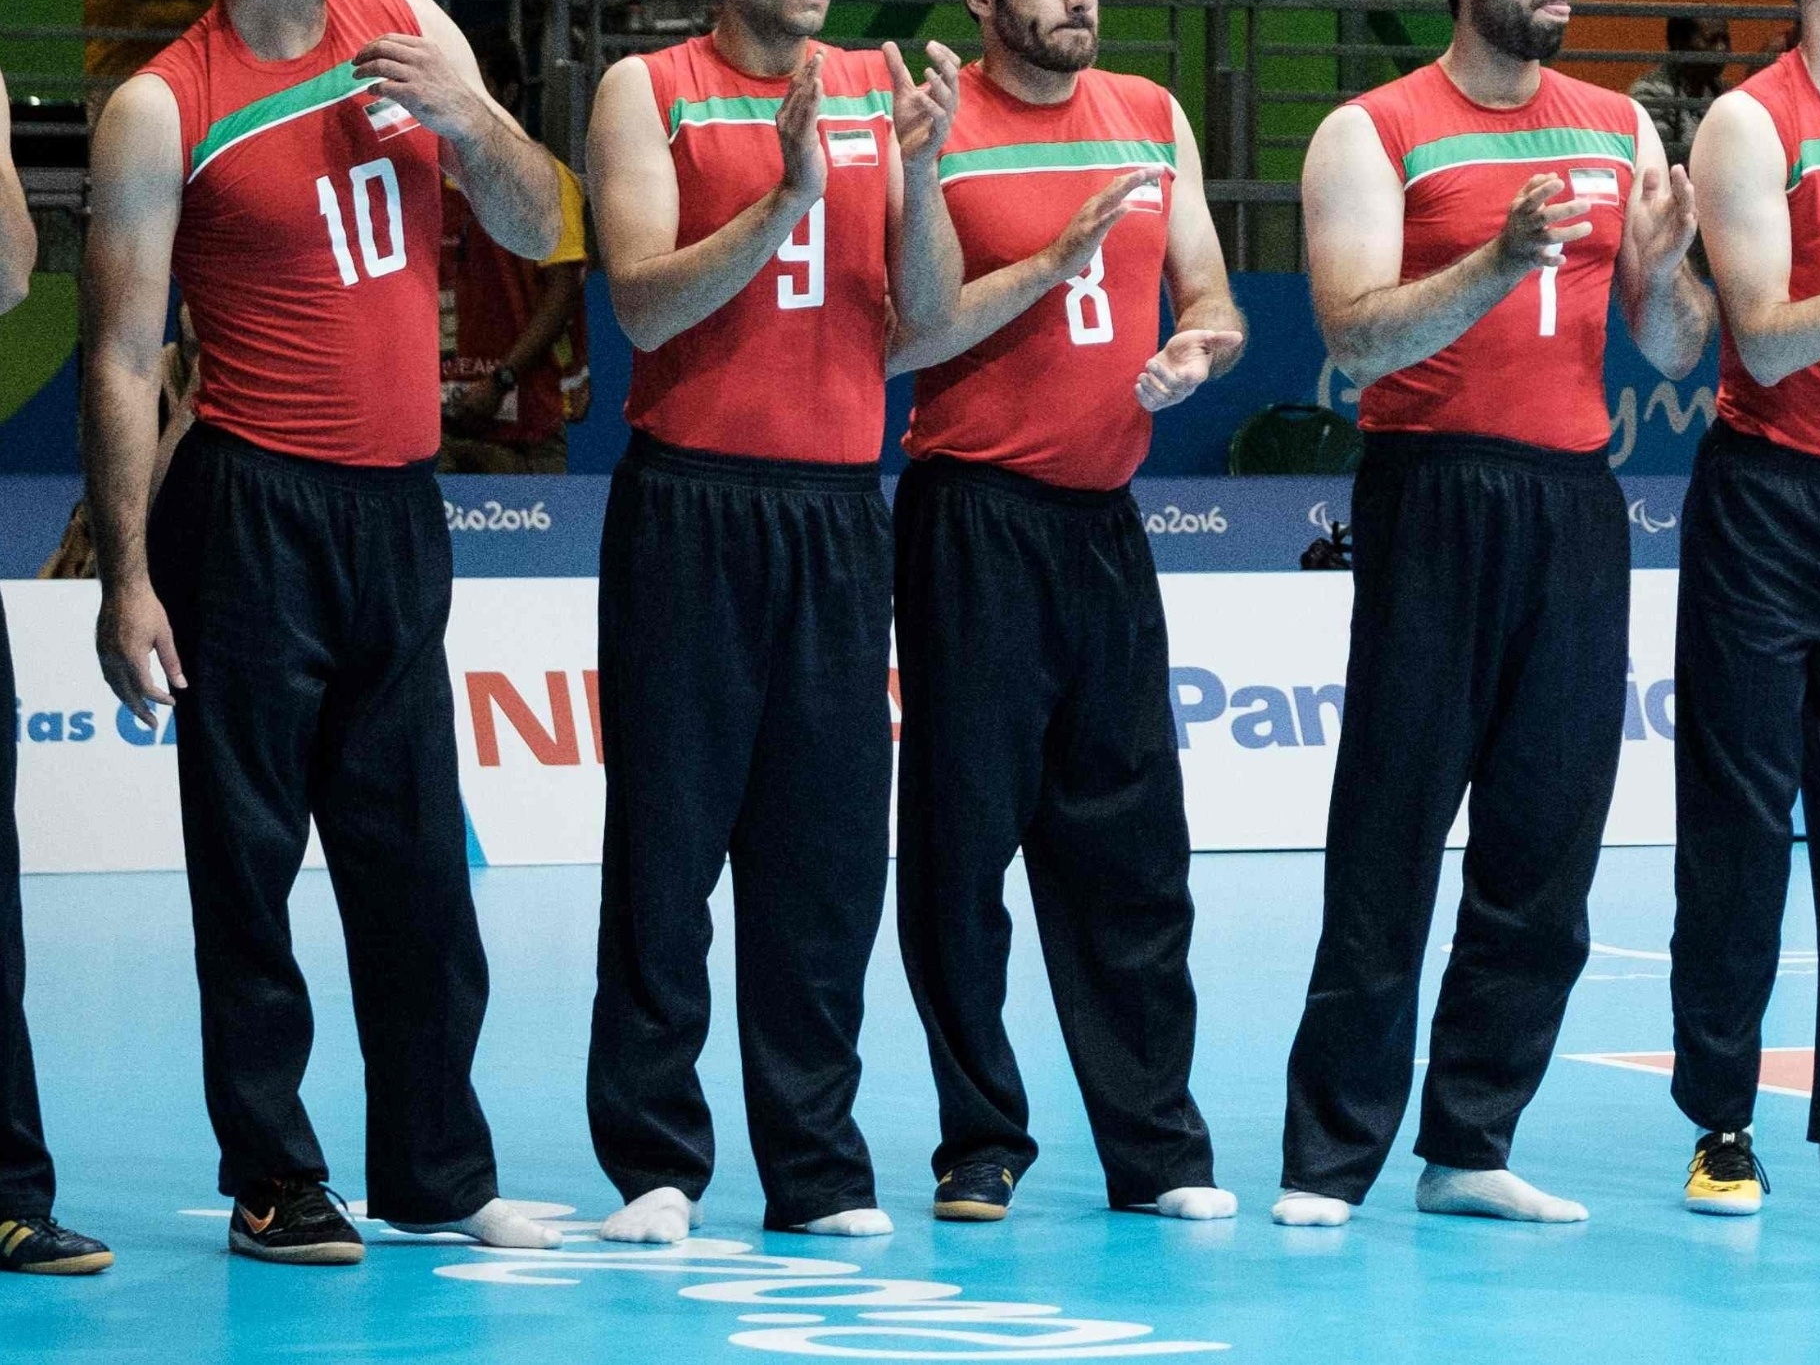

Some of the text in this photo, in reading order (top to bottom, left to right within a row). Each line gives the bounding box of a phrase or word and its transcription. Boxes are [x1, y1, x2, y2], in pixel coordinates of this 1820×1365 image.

[316, 156, 408, 288] 10
[776, 197, 826, 310] 9
[1063, 246, 1115, 346] 8
